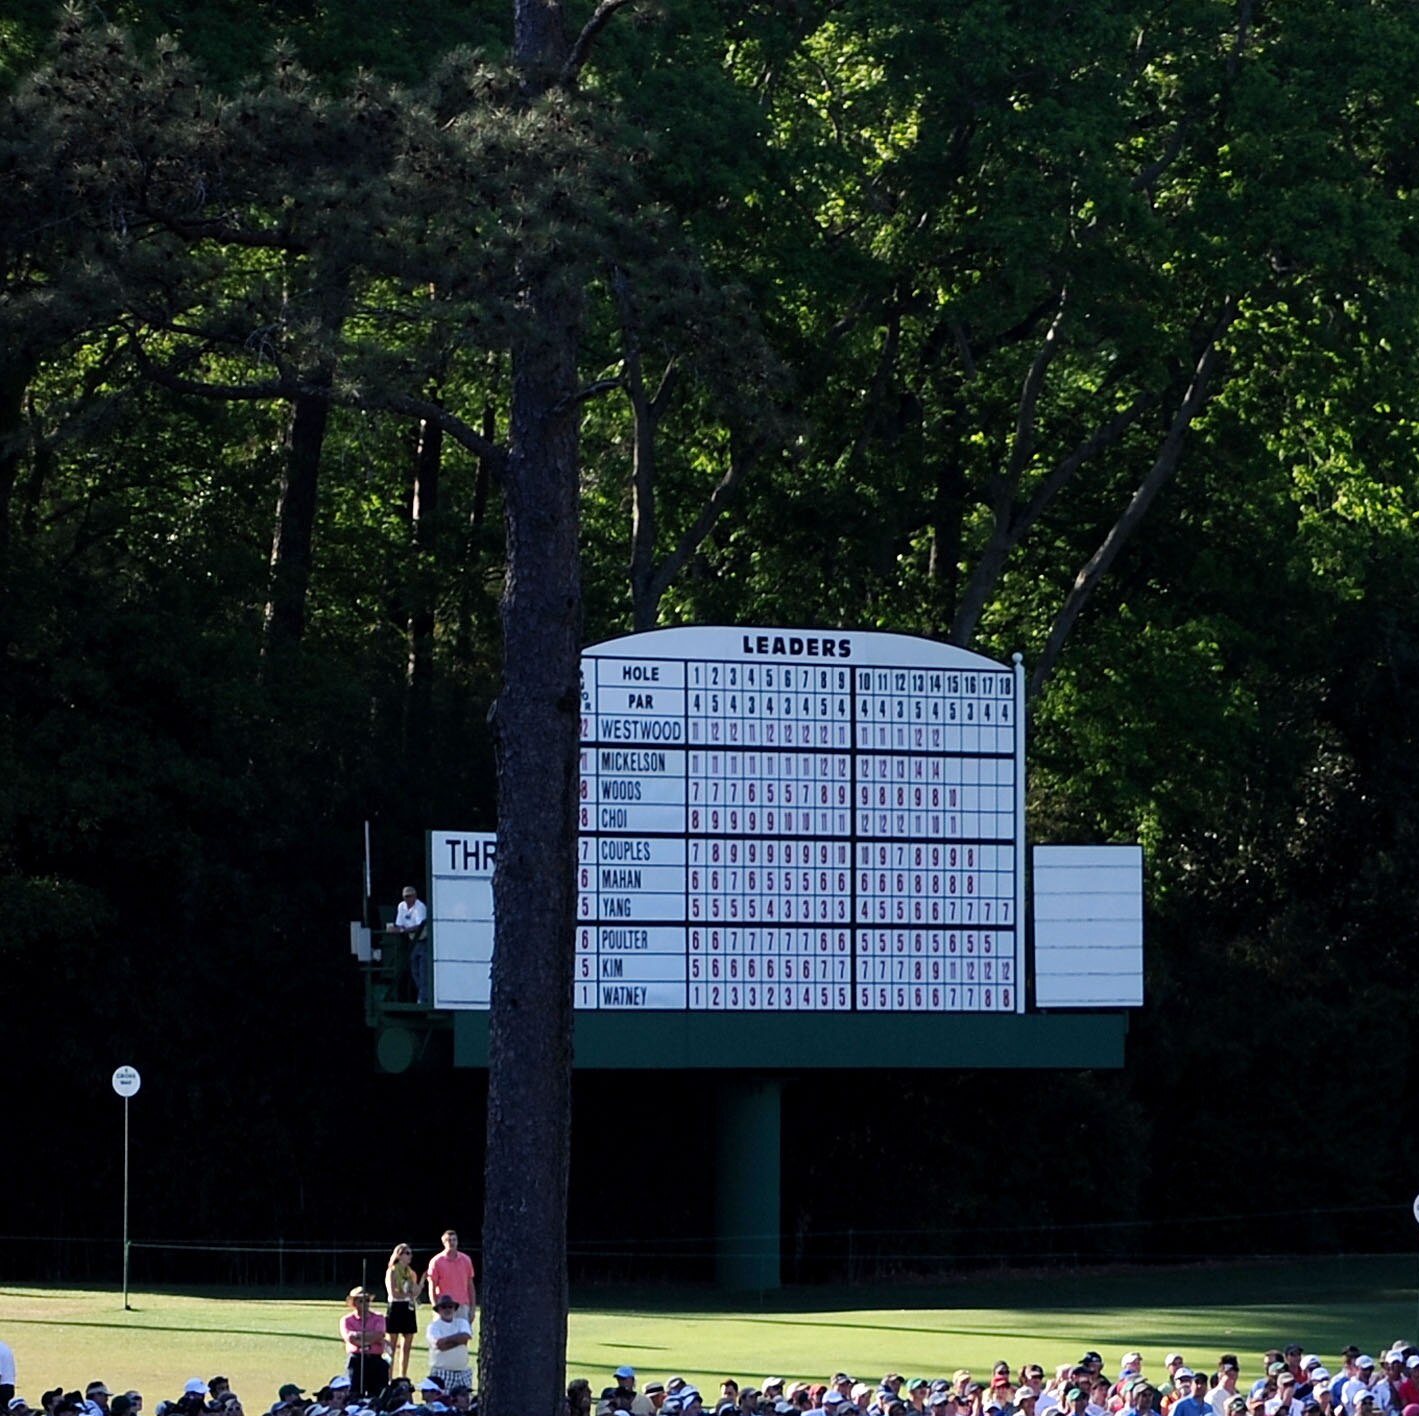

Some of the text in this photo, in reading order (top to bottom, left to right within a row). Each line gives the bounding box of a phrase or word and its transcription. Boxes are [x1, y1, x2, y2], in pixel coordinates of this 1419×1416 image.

[743, 636, 851, 657] LEADERS
[623, 666, 1012, 695] HOLE 1 2 3 4 5 6 7 8 9 10 11 12 13 14 15 16 17 18
[629, 694, 1009, 721] PAR 4 5 4 3 4 3 4 5 4 4 4 3 5 4 5 3 4 4
[602, 720, 681, 740] WESTWOOD
[602, 752, 665, 772] MICKELSON
[579, 780, 641, 800] 8 WOODS
[581, 808, 627, 828] 8 CHOI
[446, 839, 497, 871] THR
[581, 841, 974, 867] 7 COUPLES 7 8 9 9 9 9 9 9 9 7 8 9 9 8
[581, 869, 974, 894] 6 MAHAN 6 6 7 6 5 5 5 6 6 6 6 6 8 8 8 8
[581, 897, 1009, 921] 5 YANG 5 5 5 5 4 3 3 3 3 4 5 5 6 6 7 7 7 7
[581, 930, 992, 953] 6 POULTER 6 6 7 7 7 7 7 6 6 5 5 5 6 5 6 5 5
[581, 958, 846, 979] 5 KIM 5 6 6 6 6 5 6 7 7
[582, 986, 1010, 1007] 1 WATNEY 1 2 3 3 2 3 4 5 5 5 5 5 6 6 7 7 8 8
